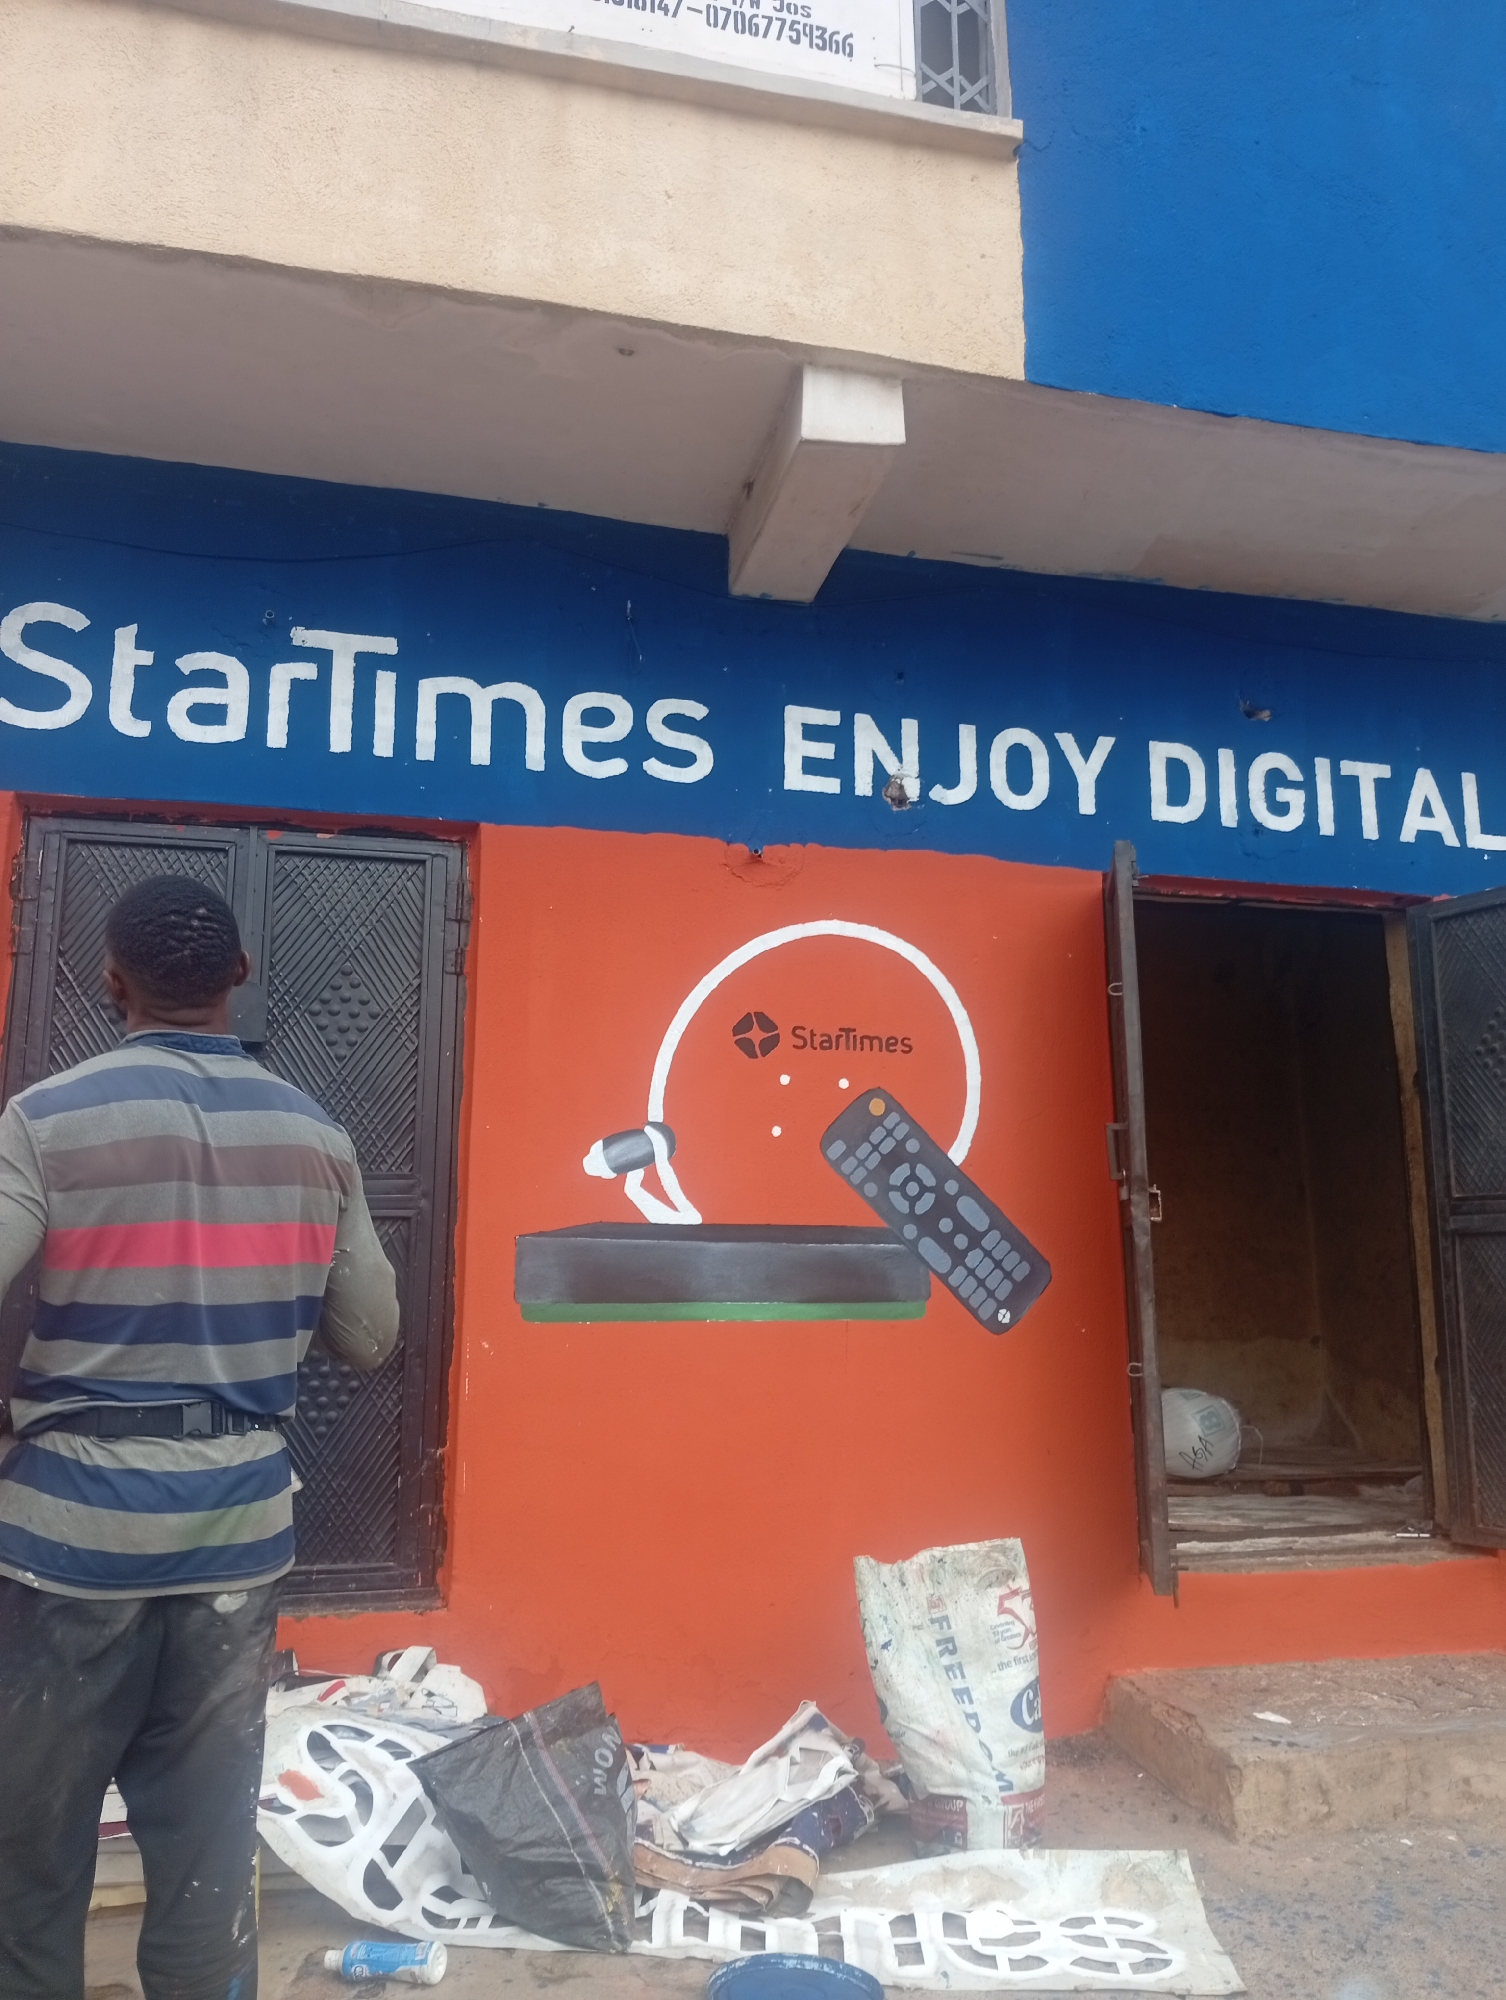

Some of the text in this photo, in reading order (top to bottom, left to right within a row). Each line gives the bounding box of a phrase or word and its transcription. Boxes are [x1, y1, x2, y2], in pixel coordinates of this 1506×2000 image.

[0, 601, 1506, 851] StarTimes ENJOY DIGITAL
[791, 1025, 913, 1054] StarTimes
